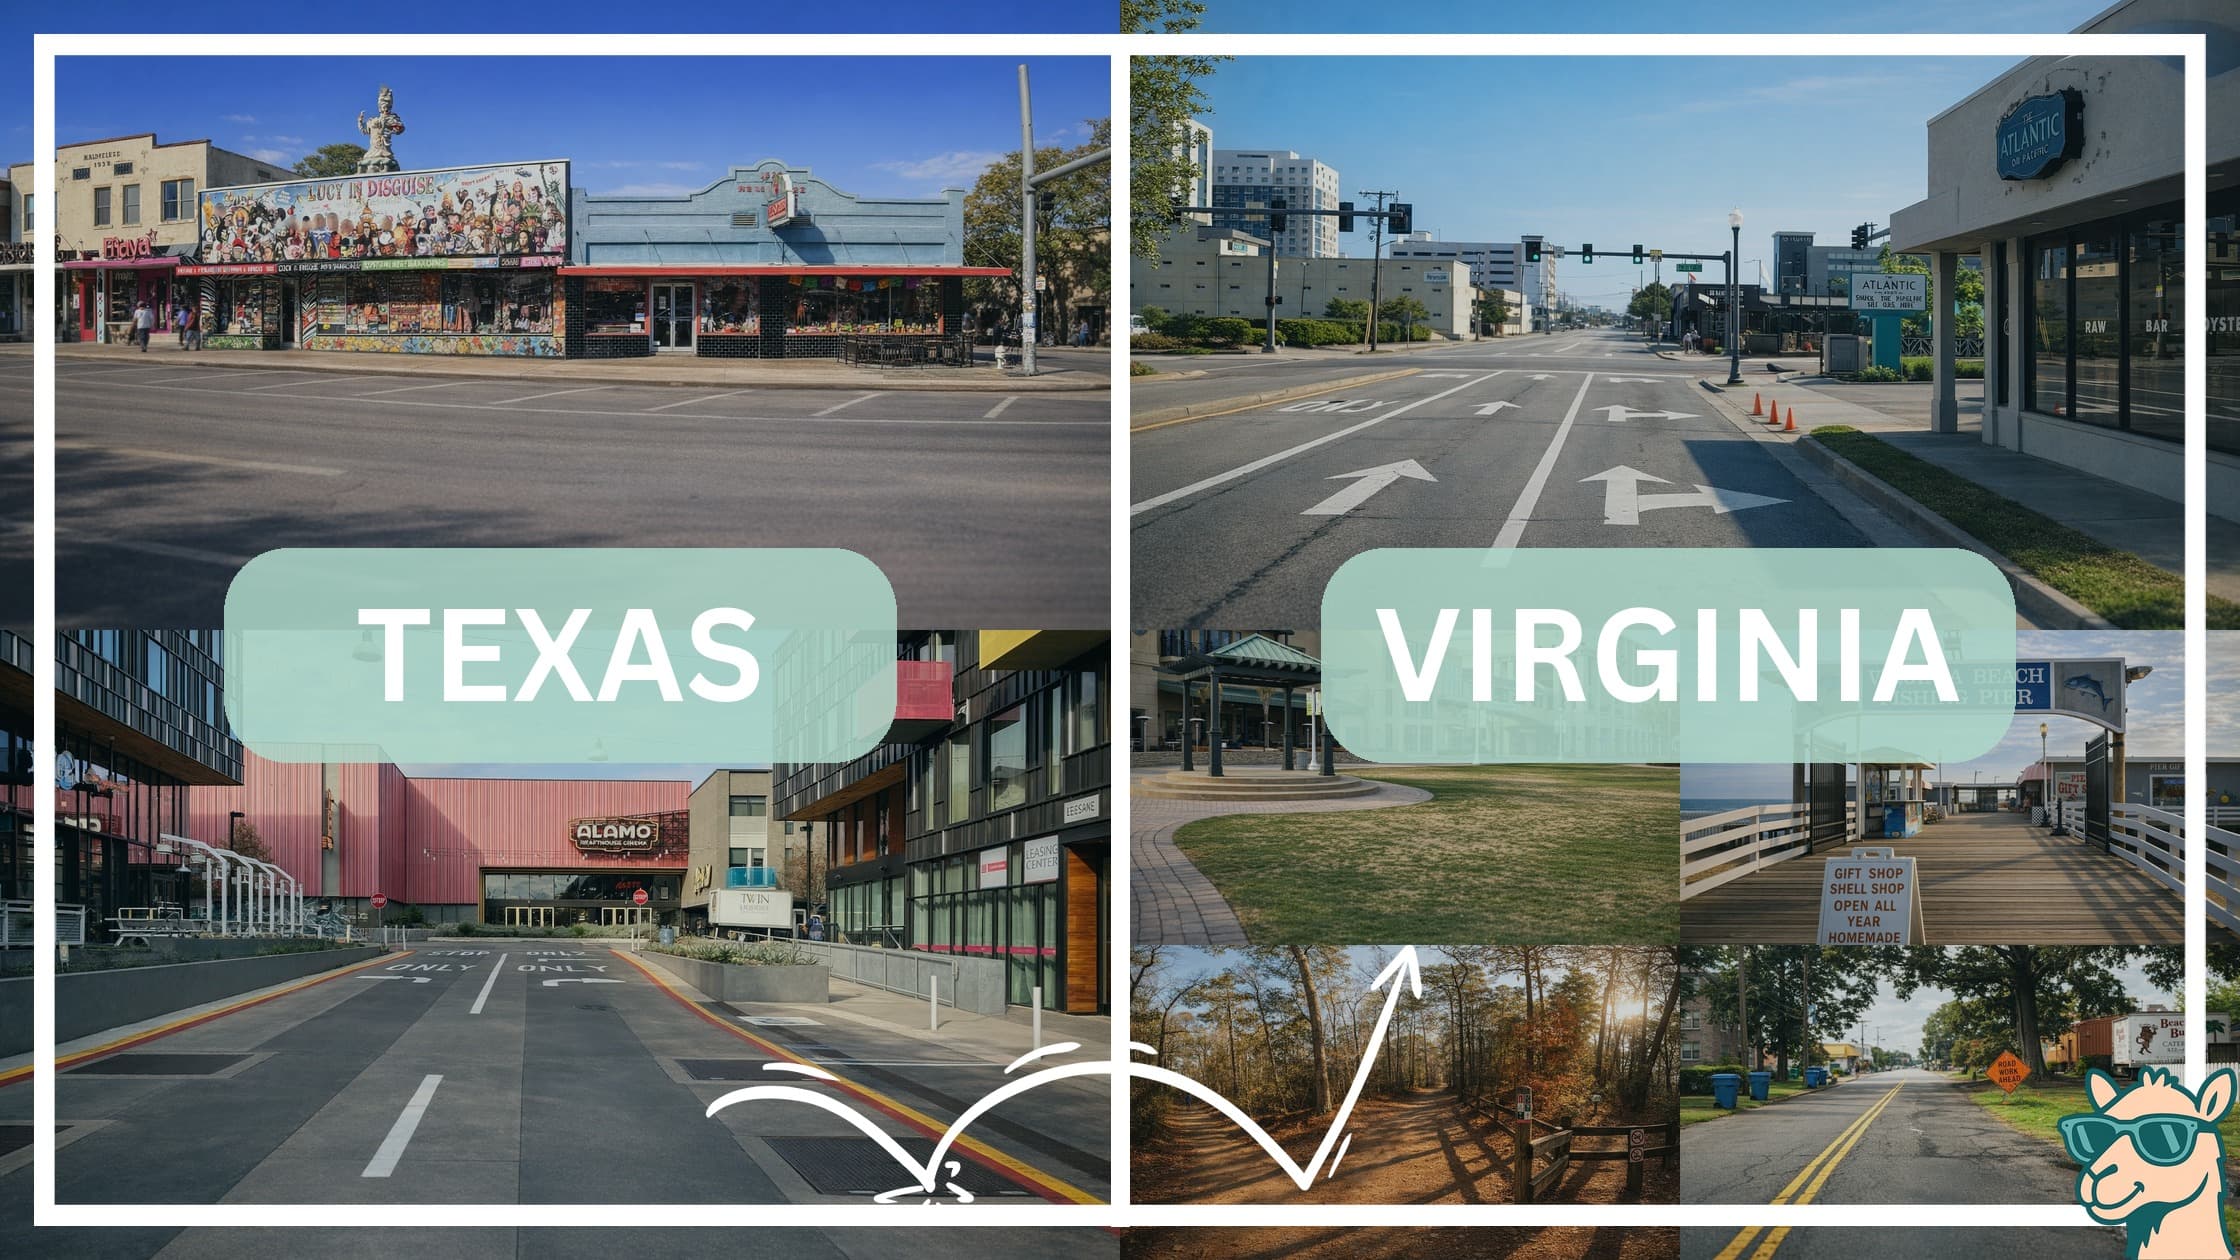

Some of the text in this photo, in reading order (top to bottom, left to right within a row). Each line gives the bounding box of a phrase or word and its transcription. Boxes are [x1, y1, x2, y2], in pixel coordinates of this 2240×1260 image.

[2000, 112, 2060, 158] ATLANTIC
[2022, 144, 2049, 163] PACIFIC
[308, 176, 435, 201] LUCY IN DISGUISE
[1862, 280, 1916, 291] ATLANTIC
[2085, 321, 2107, 334] RAW
[2145, 320, 2168, 333] BAR
[2071, 774, 2086, 782] PIE
[2058, 782, 2079, 794] GIFT
[1066, 801, 1095, 816] LEESANE
[577, 825, 651, 839] ALAMO
[1026, 844, 1059, 860] LEASING
[1026, 857, 1058, 870] CENTER
[1834, 868, 1903, 879] GIFT SHOP
[1830, 883, 1904, 894] SHELL SHOP
[742, 893, 769, 904] TWIN
[1834, 900, 1896, 911] OPEN ALL
[1848, 916, 1880, 927] YEAR
[1828, 932, 1900, 943] HOMEMADE
[517, 964, 609, 972] ONLY
[2000, 1068, 2018, 1076] WORK
[1999, 1075, 2021, 1083] AHEAD
